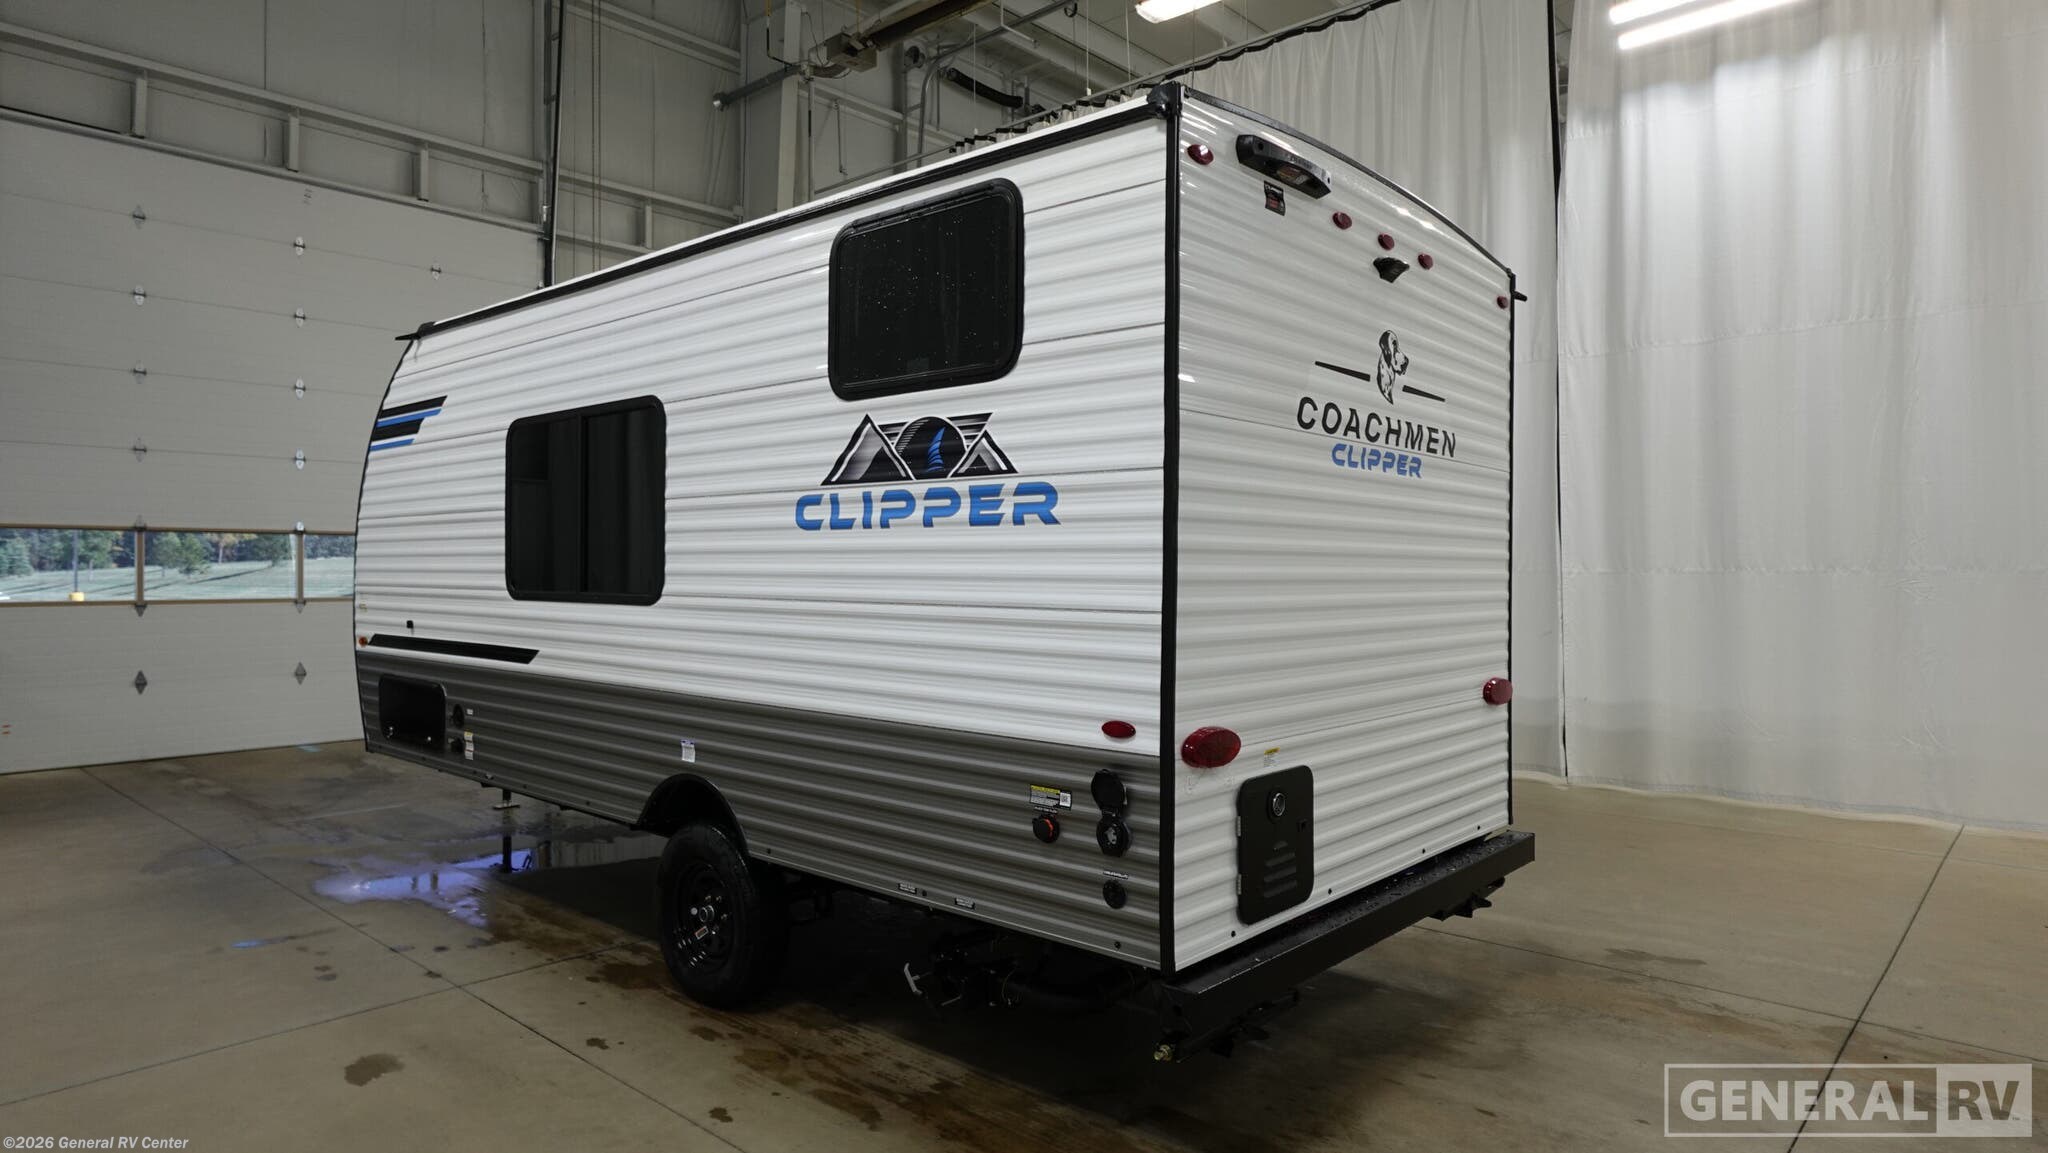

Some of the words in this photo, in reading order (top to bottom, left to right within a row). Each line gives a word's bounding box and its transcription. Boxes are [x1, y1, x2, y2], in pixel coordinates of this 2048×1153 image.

[1297, 396, 1456, 458] COACHMEN
[1332, 443, 1422, 479] CLIPPER
[795, 481, 1061, 531] CLIPPER
